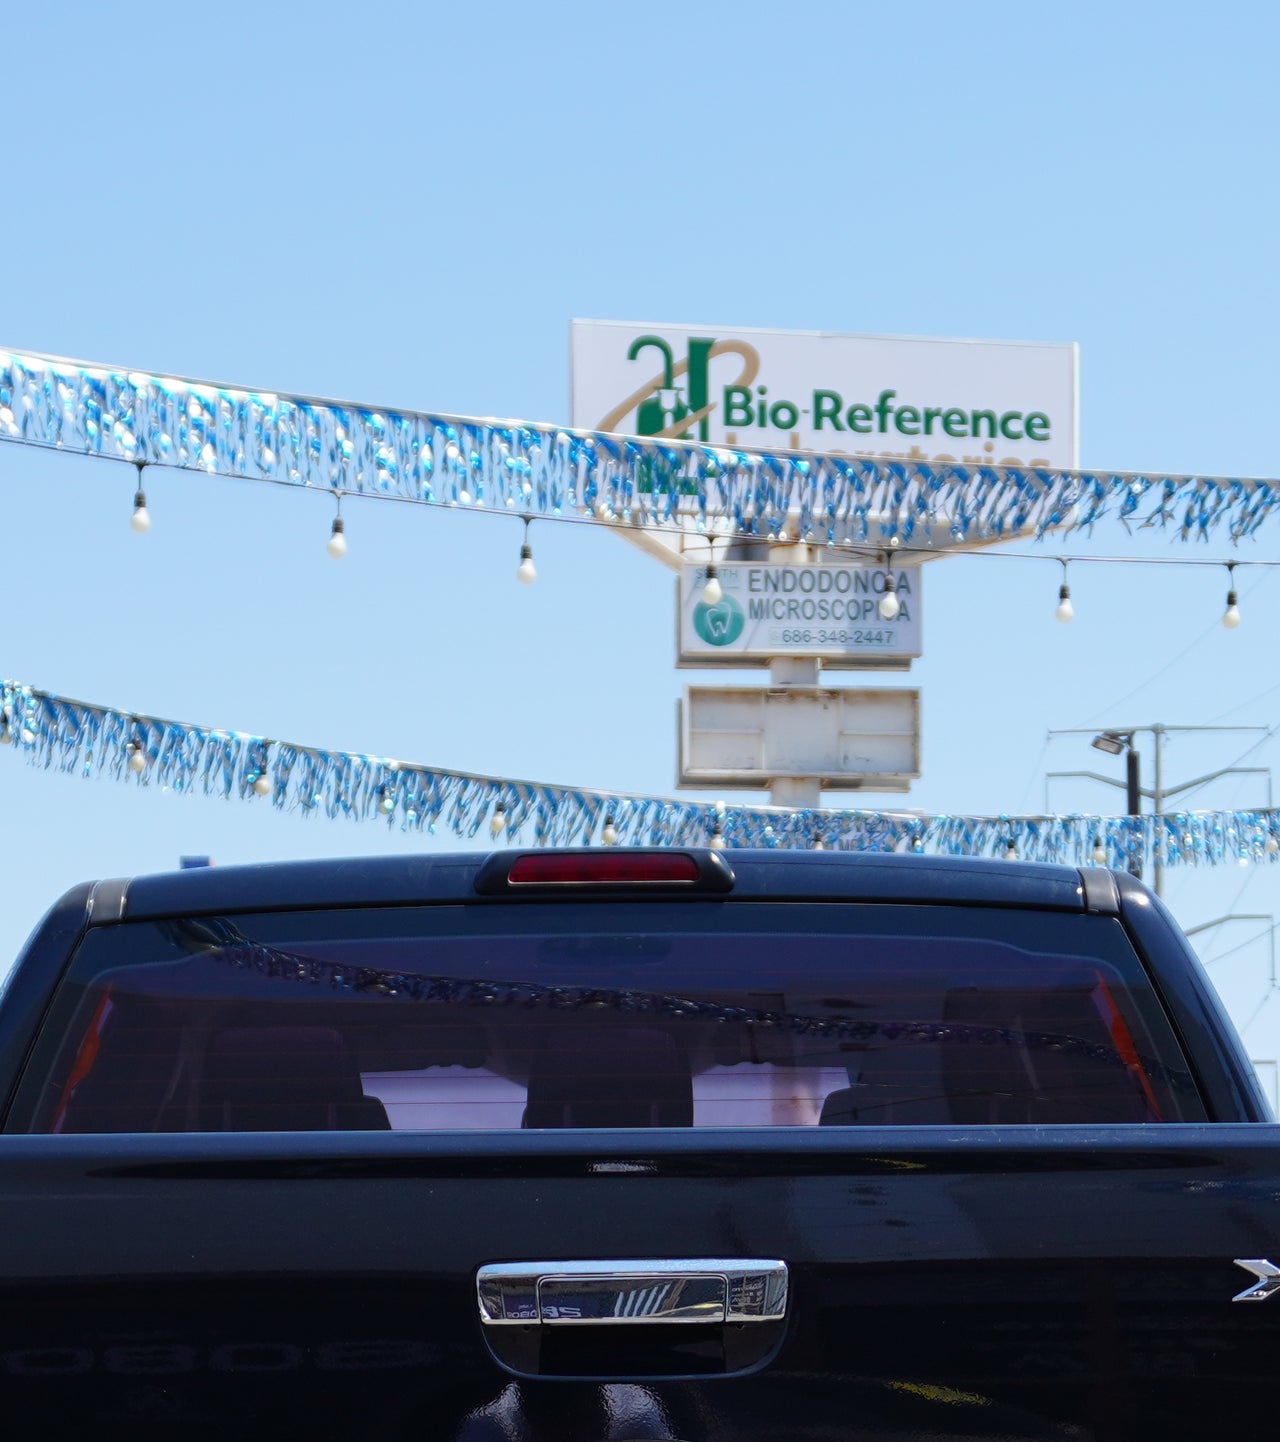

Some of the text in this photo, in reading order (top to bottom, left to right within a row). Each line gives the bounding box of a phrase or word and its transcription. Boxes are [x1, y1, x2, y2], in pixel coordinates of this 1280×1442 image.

[748, 568, 912, 595] ENDODONCA
[748, 598, 911, 622] MICROSCOPIA
[782, 629, 894, 645] 686-348-2447
